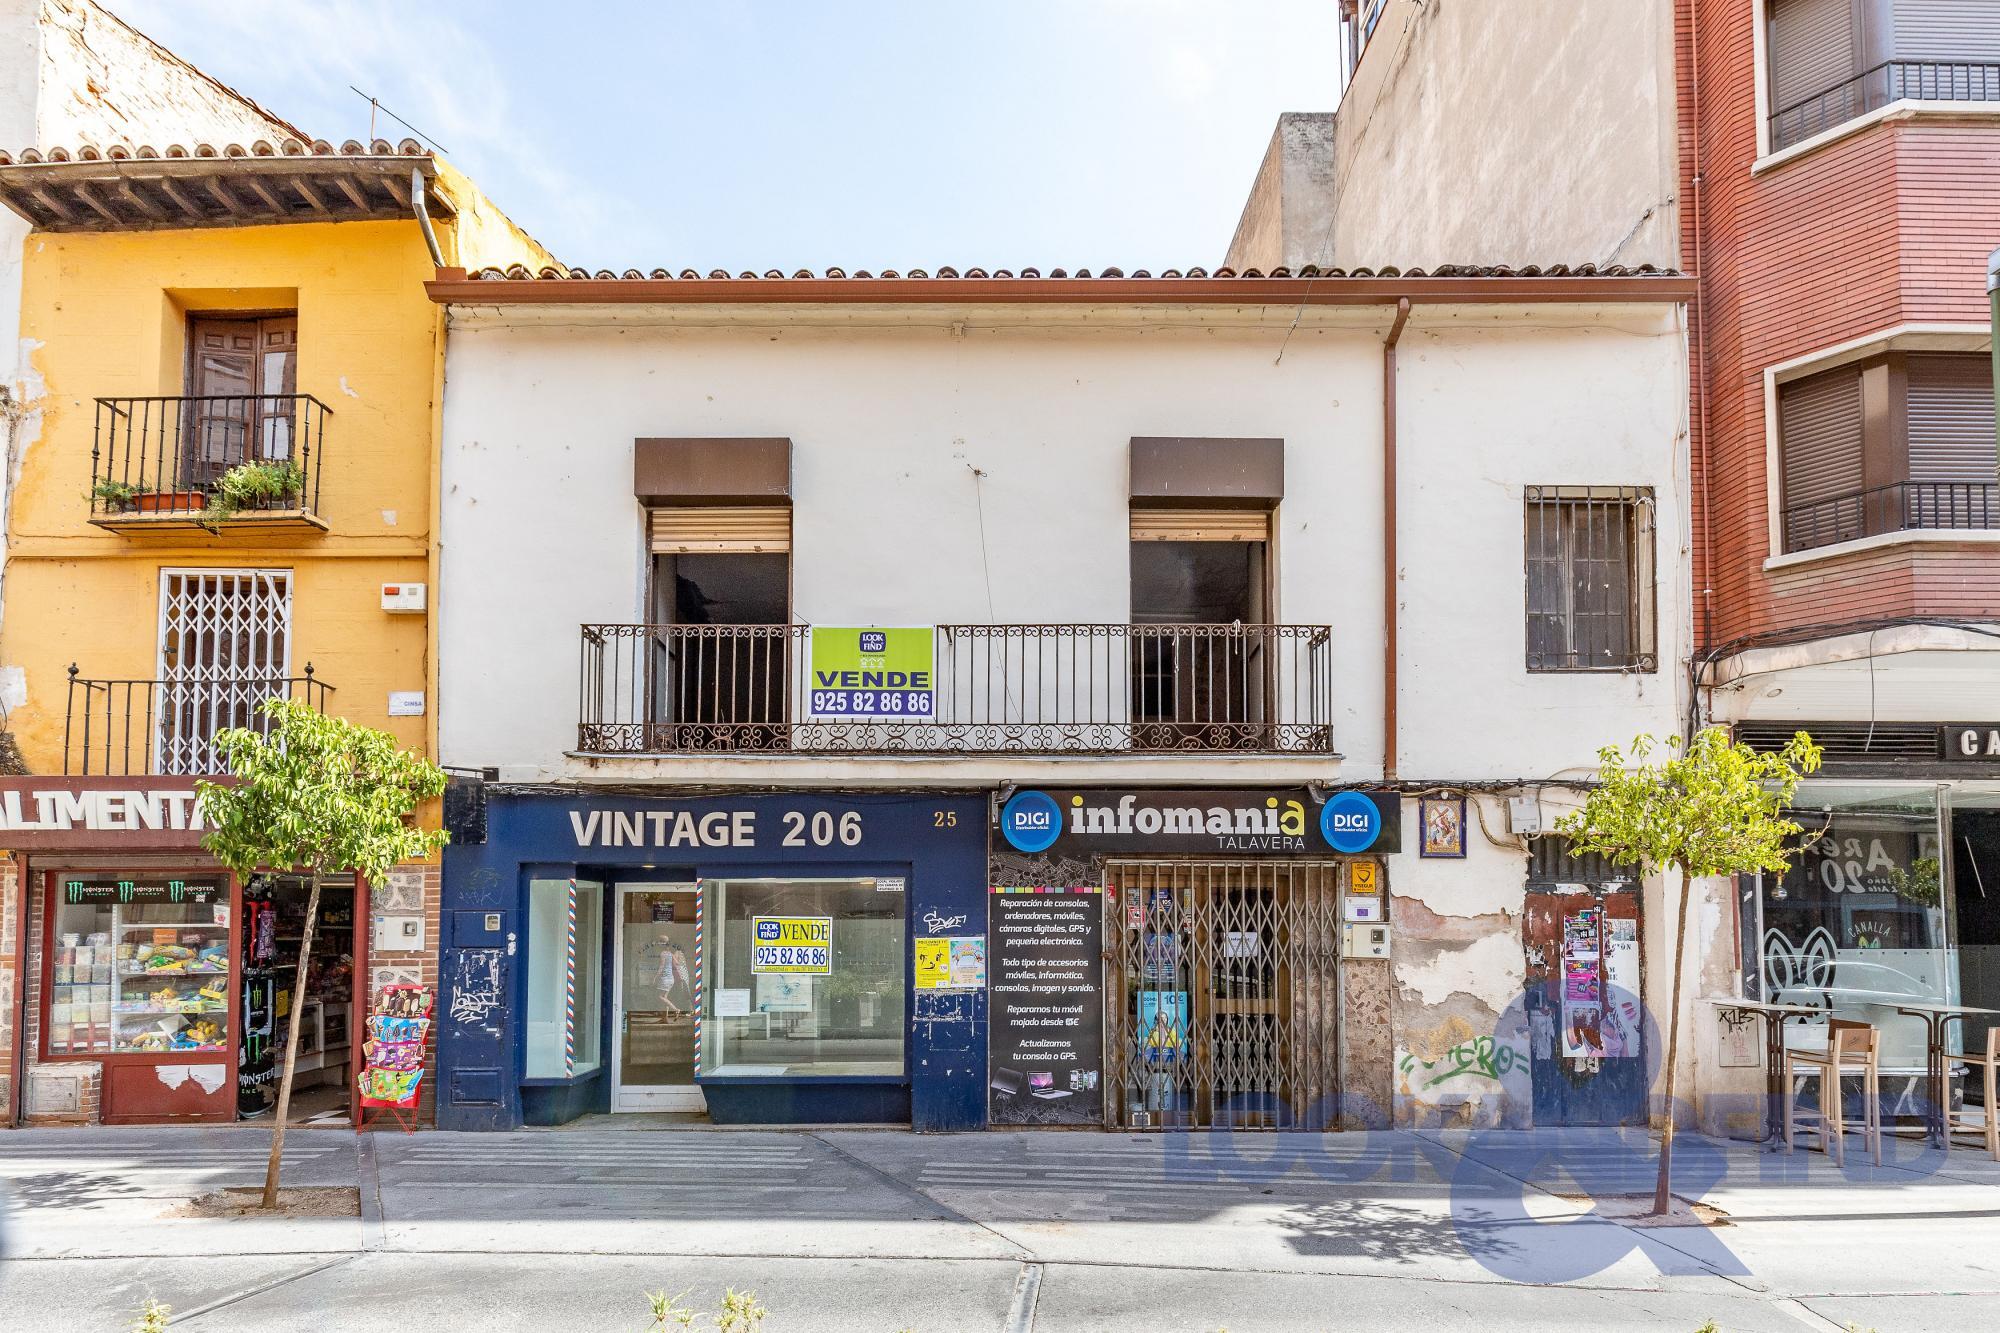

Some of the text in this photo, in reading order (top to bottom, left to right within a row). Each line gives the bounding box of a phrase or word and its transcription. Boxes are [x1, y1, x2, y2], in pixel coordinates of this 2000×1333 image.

[862, 634, 883, 642] LOOK
[863, 643, 882, 651] FIND
[816, 671, 929, 687] VENDE
[814, 691, 930, 712] 925 82 86 86
[934, 811, 957, 827] 25
[1015, 812, 1049, 825] DIGI
[1070, 794, 1305, 836] infomania
[1334, 814, 1368, 828] DIGI
[569, 810, 863, 847] VINTAGE 206
[1216, 836, 1306, 849] TALAVERA
[1000, 899, 1090, 909] Reparación de consolas,
[1004, 912, 1085, 920] ordenadores, móviles,
[782, 924, 829, 940] VENDE
[999, 924, 1092, 935] cámaras digitales, GPS y
[1847, 921, 1891, 938] CANALLA
[1006, 937, 1084, 948] pequeña electrónica.
[758, 948, 826, 965] 925 82 86 86
[1002, 958, 1088, 968] Todo tipo de accesorios
[1006, 970, 1084, 980] móviles, informática,
[995, 984, 1095, 994] consolas, imagen y sonido.
[1007, 1005, 1050, 1015] Reparamos
[1010, 1018, 1040, 1028] mojado
[1040, 1018, 1064, 1026] desde
[1019, 1040, 1071, 1048] Actualizamos
[1012, 1052, 1022, 1060] tu
[1022, 1052, 1052, 1060] consola
[1060, 1052, 1078, 1060] GPS.
